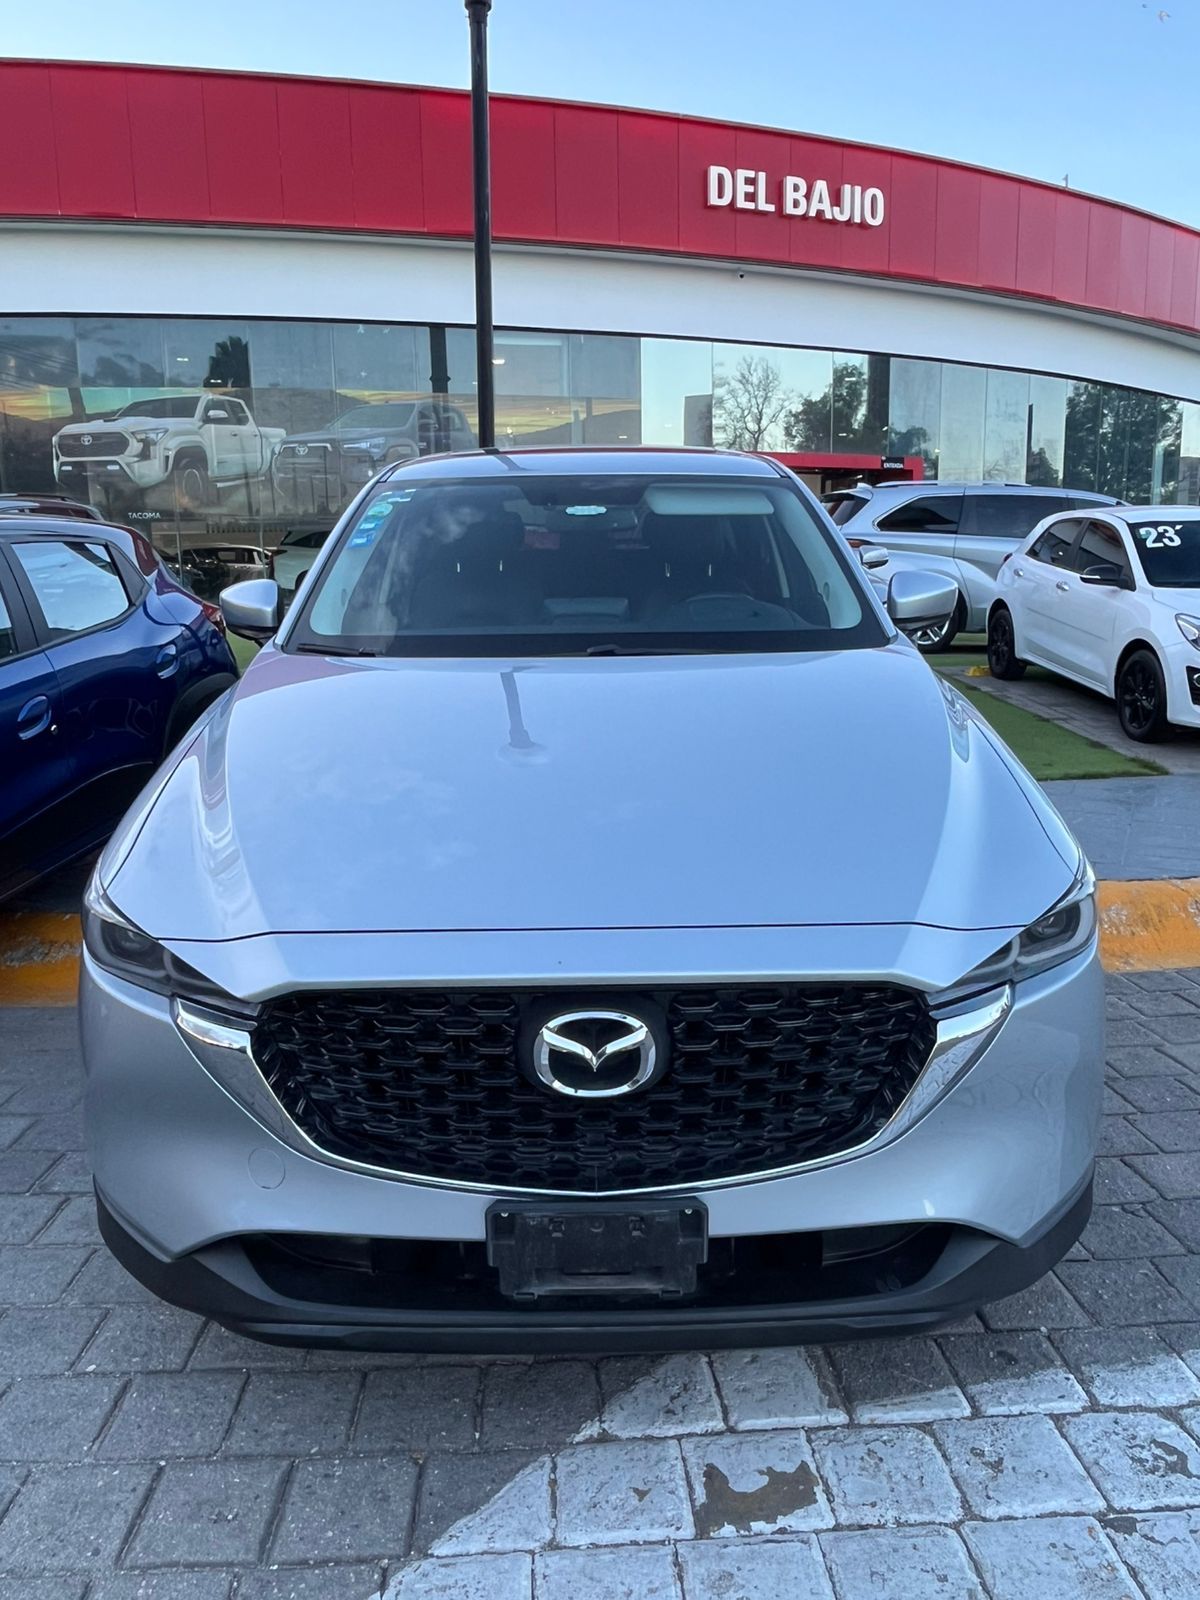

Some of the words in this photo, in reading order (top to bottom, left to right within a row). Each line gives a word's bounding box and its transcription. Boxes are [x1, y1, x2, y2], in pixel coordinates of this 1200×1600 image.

[708, 165, 775, 212] DEL
[783, 175, 885, 226] BAJIO
[127, 512, 161, 520] TACOMA
